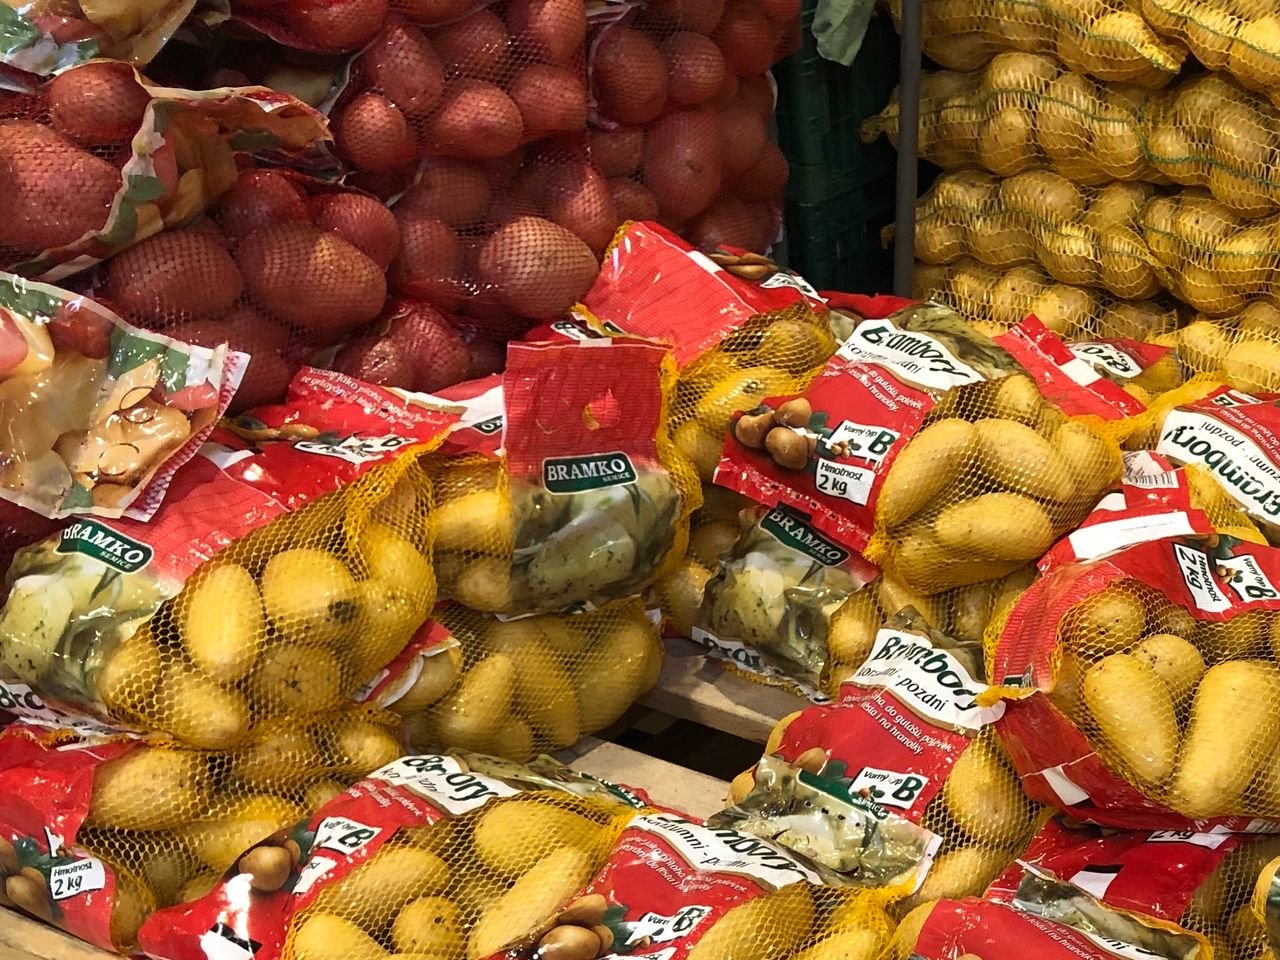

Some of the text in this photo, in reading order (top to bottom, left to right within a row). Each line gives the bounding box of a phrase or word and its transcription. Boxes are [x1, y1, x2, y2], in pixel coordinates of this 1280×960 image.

[868, 430, 896, 455] B
[1200, 421, 1245, 448] pozdní
[547, 459, 626, 482] BRAMKO
[820, 462, 863, 481] Hmotnost
[818, 474, 848, 495] 2 kg
[769, 508, 842, 561] BRAMKO
[1179, 547, 1203, 590] 2 kg
[1198, 555, 1222, 602] Hmotnost
[895, 676, 949, 712] pozdní
[885, 704, 897, 717] do
[880, 716, 892, 730] na
[890, 724, 925, 756] hranolky.
[864, 770, 924, 801] Varný B
[54, 862, 94, 878] Hmotnost
[54, 874, 83, 897] 2 kg
